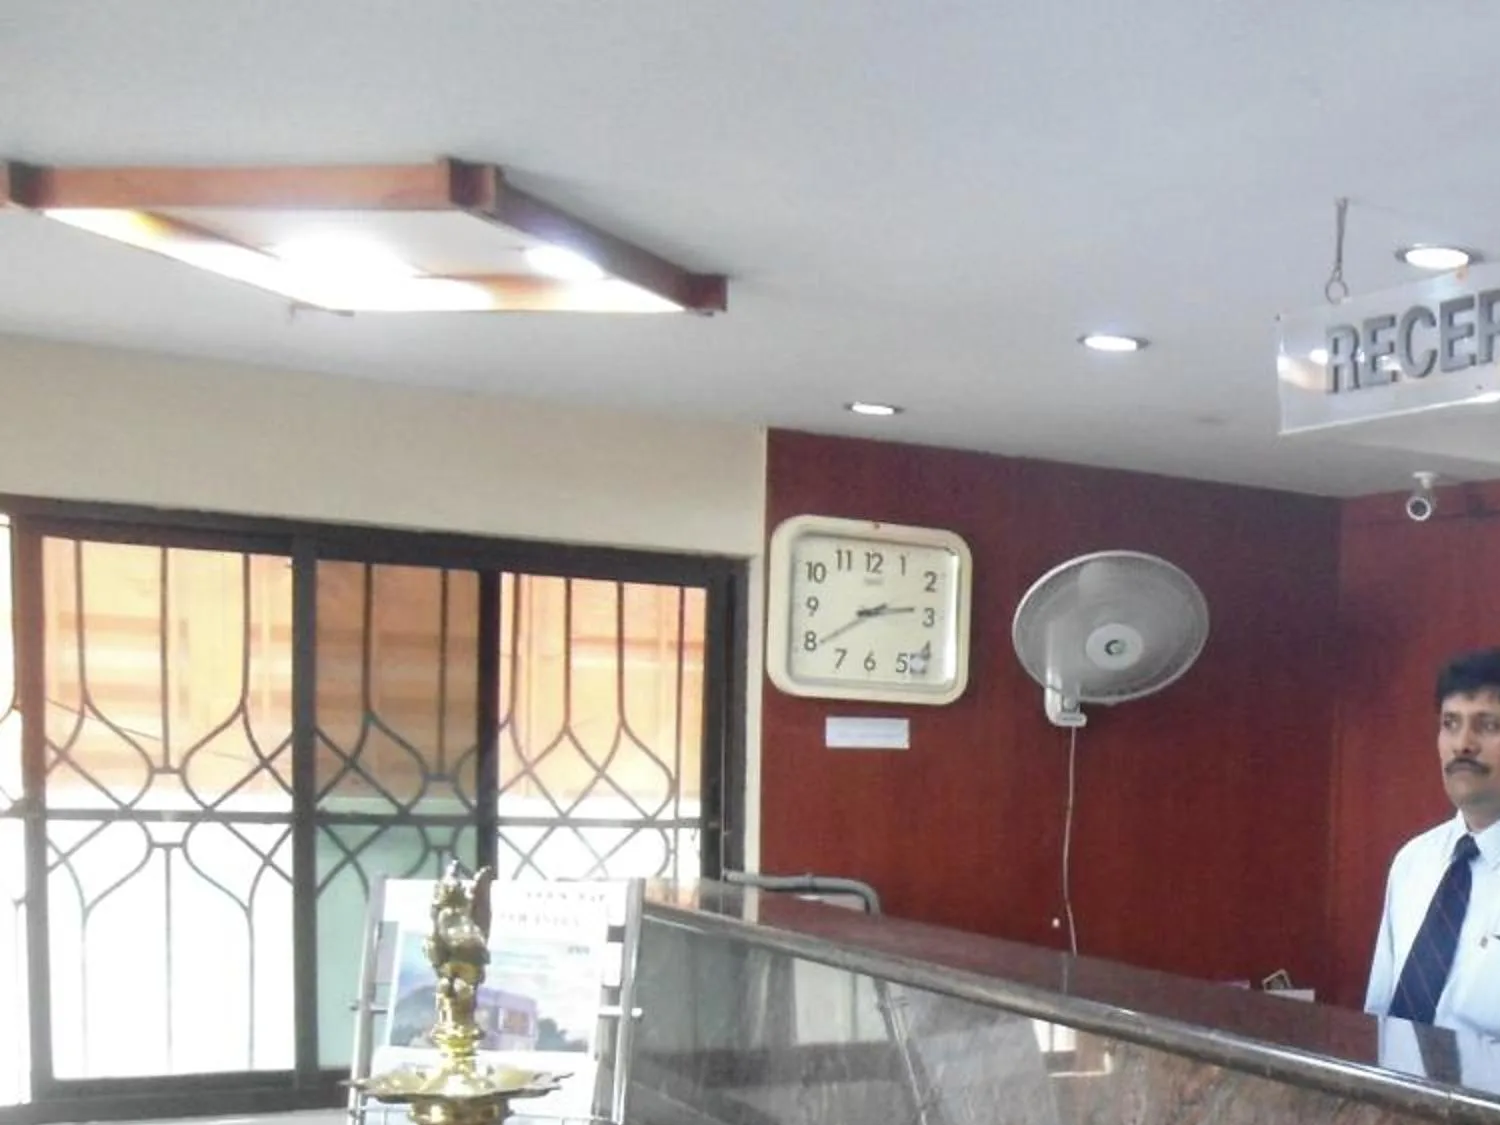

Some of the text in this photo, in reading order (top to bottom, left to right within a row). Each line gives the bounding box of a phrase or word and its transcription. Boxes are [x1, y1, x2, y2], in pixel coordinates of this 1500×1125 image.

[836, 549, 852, 571] 11
[864, 552, 884, 574] 12
[900, 555, 907, 576] 1
[806, 561, 827, 584] 10
[924, 571, 938, 592] 2
[806, 596, 819, 616] 9
[922, 607, 935, 628] 3
[804, 631, 817, 652] 8
[835, 649, 847, 669] 7
[864, 651, 876, 671] 6
[895, 653, 908, 673] 5
